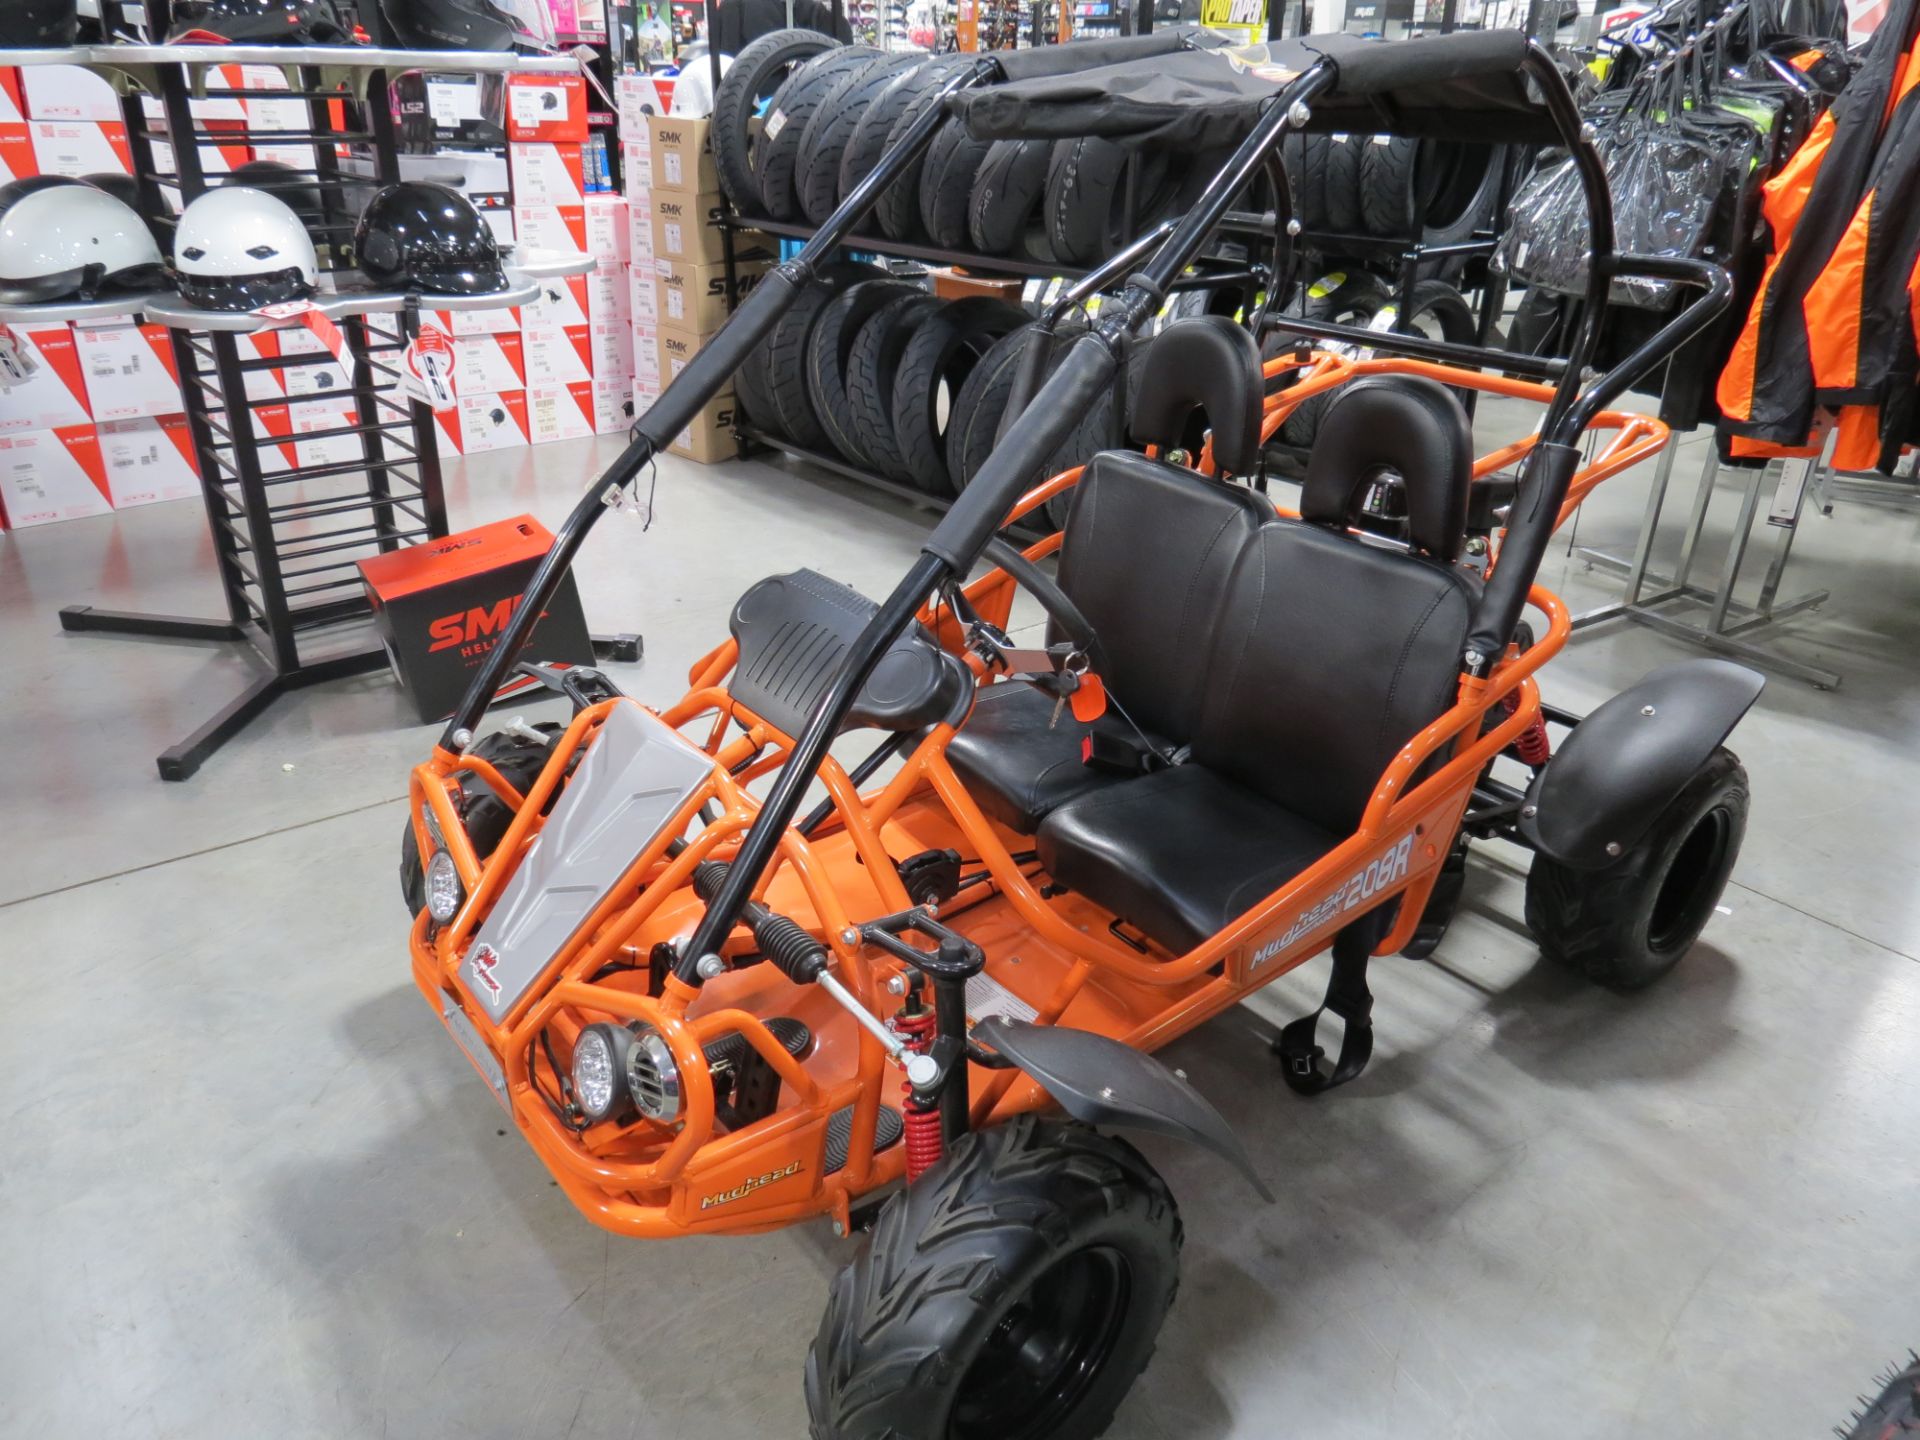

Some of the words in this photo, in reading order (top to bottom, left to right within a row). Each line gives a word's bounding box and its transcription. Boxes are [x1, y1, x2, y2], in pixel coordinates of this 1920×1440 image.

[400, 102, 424, 114] LS2
[659, 130, 682, 144] SMK
[660, 203, 683, 217] SMK
[665, 338, 687, 353] SMK
[1343, 833, 1413, 912] 208R
[701, 1160, 805, 1210] Mudhead
